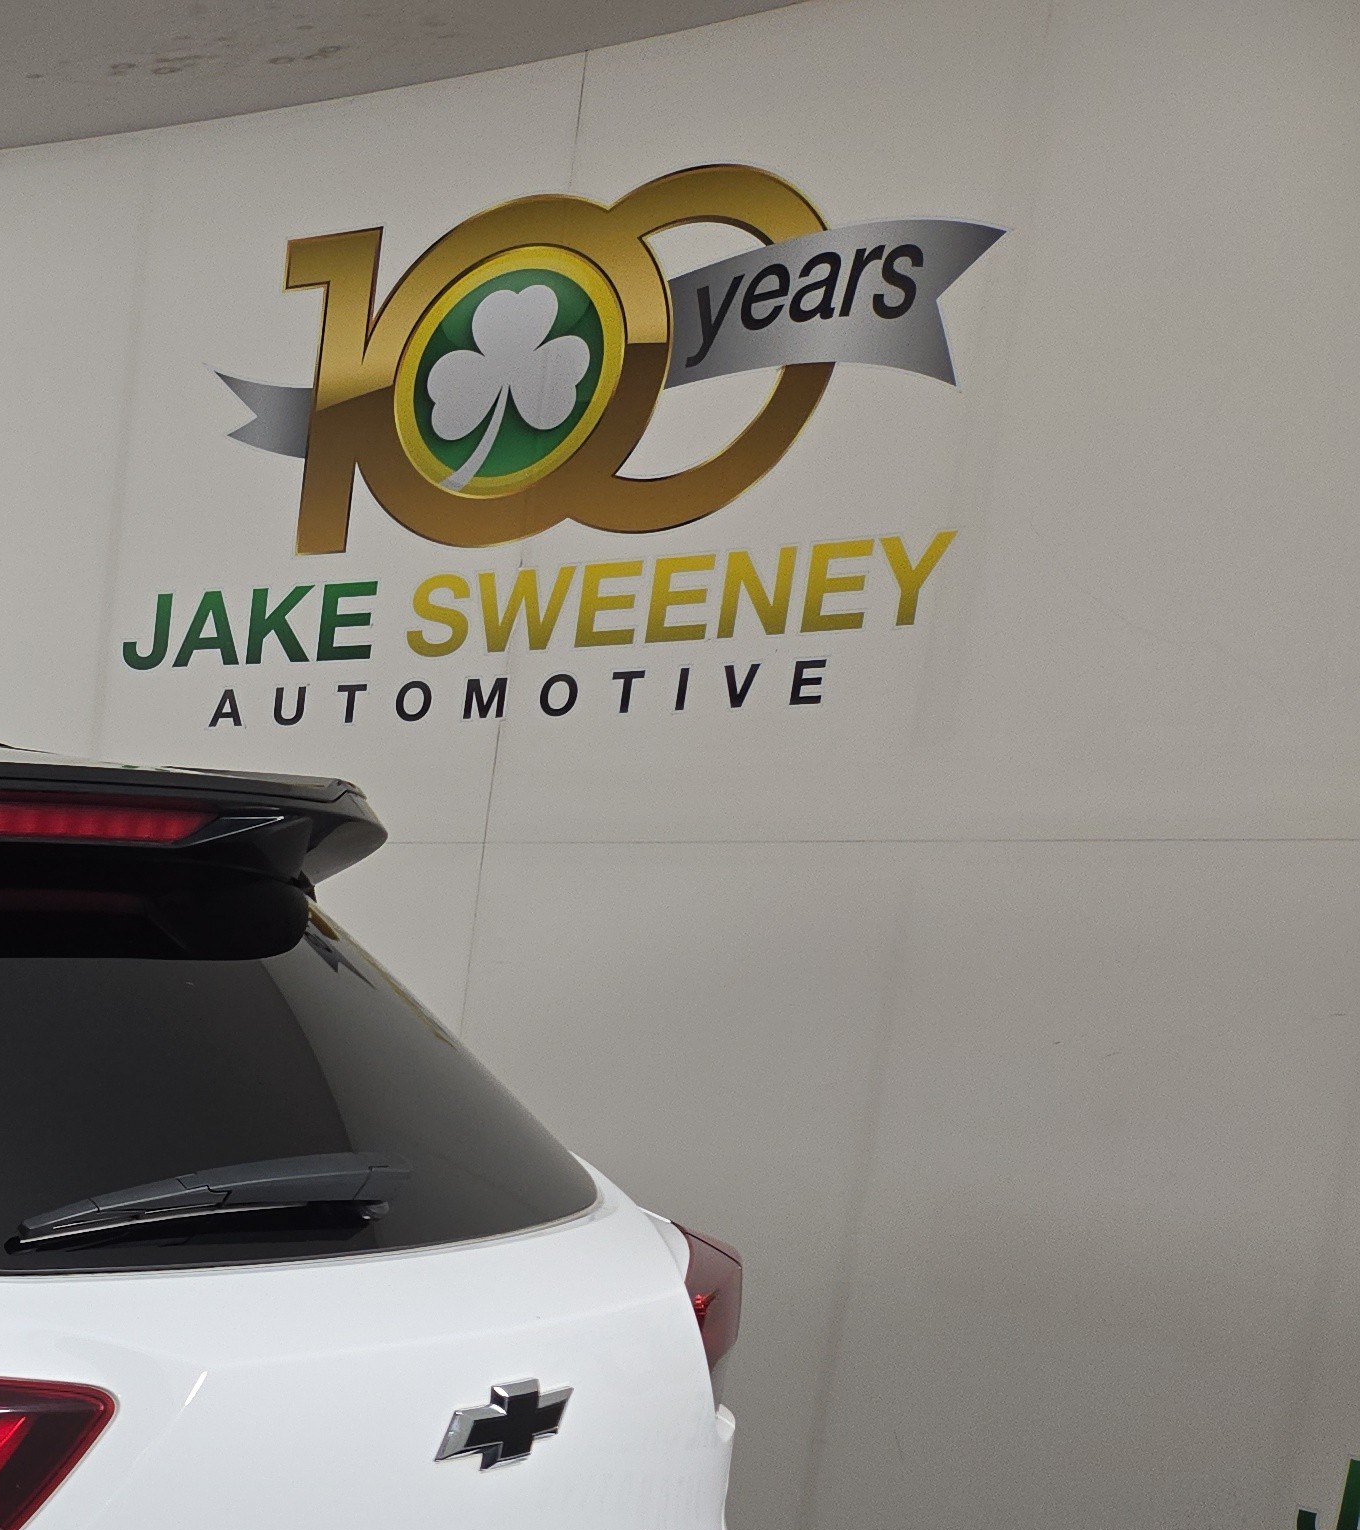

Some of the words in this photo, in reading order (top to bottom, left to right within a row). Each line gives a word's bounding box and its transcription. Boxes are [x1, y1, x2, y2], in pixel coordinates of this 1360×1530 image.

[685, 238, 925, 369] years
[121, 580, 379, 671] JAKE
[405, 531, 959, 658] SWEENEY
[208, 659, 828, 728] AUTOMOTIVE
